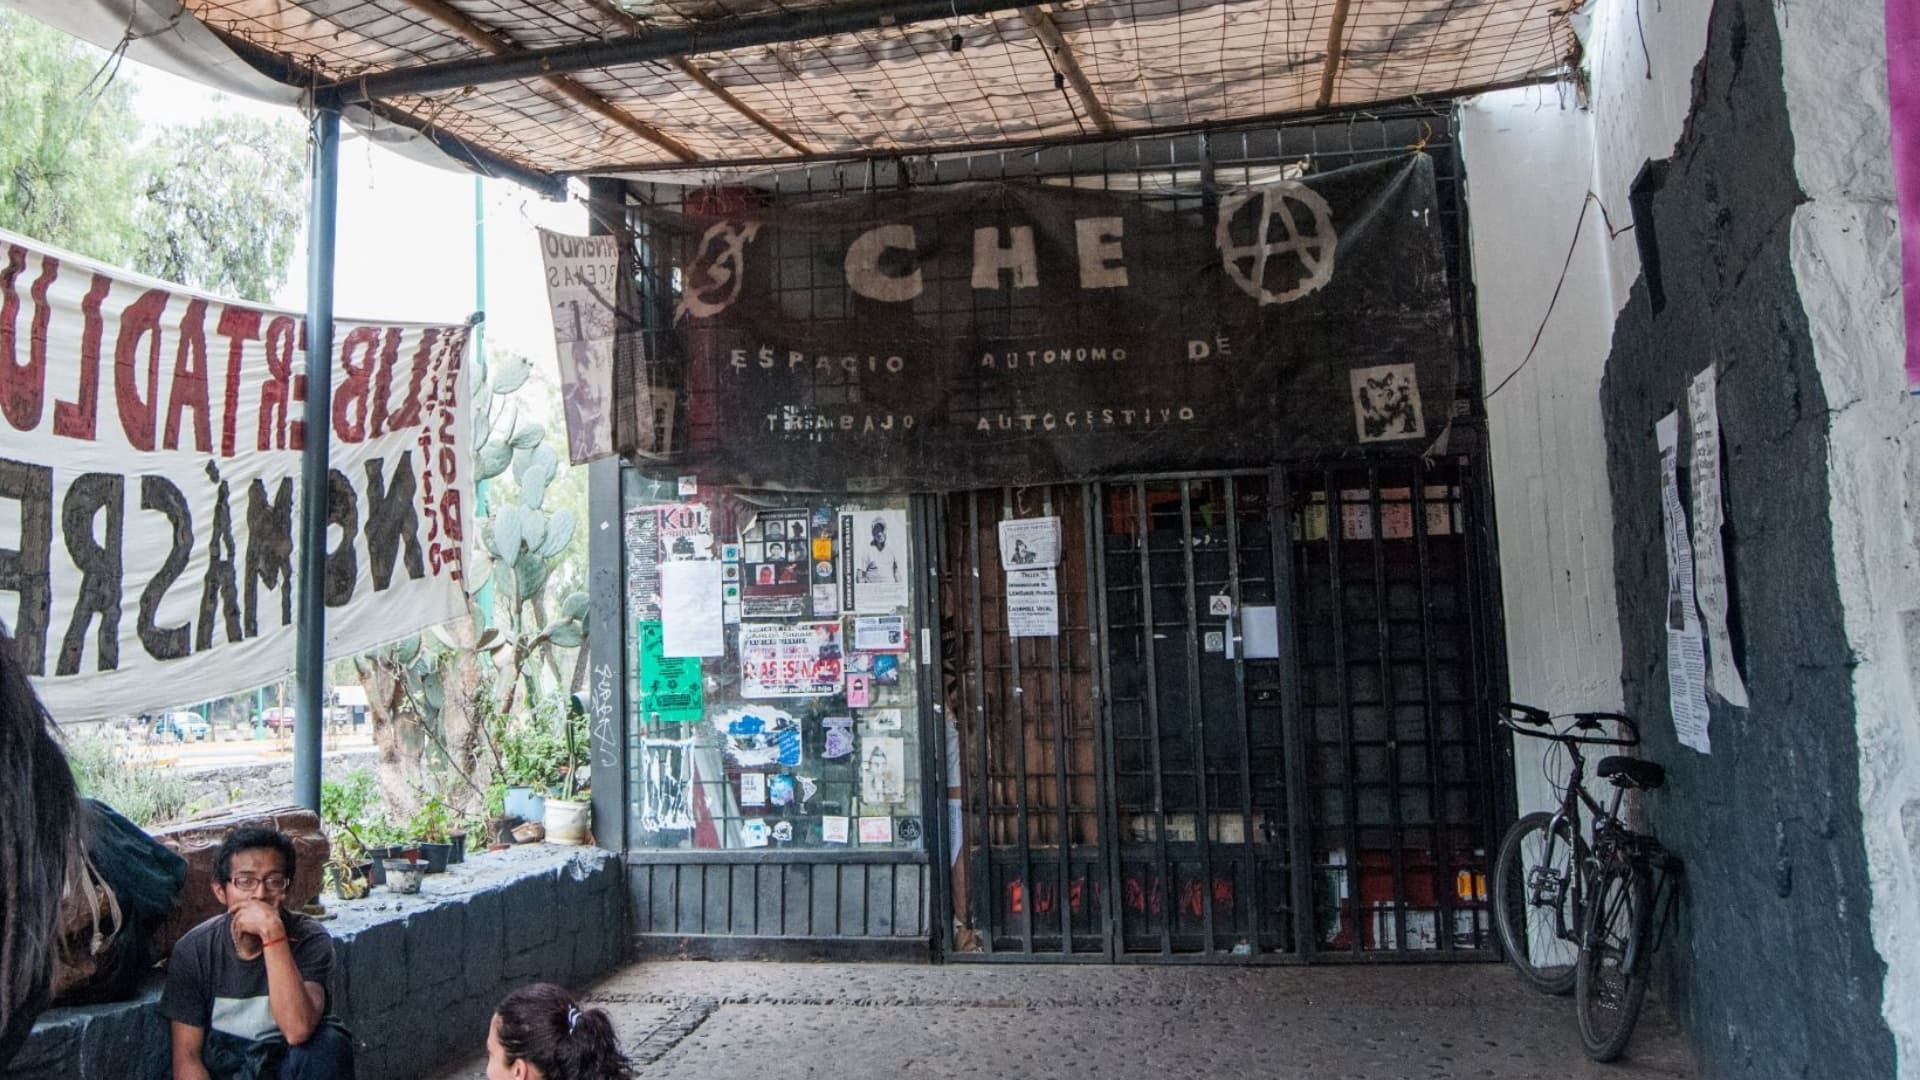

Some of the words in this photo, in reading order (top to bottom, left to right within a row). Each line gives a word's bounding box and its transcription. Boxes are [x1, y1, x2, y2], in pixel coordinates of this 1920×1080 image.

[844, 217, 1129, 301] CHE
[731, 349, 904, 373] ESPACIO
[981, 348, 1126, 369] AUTONOMO
[1188, 336, 1231, 360] DE
[767, 413, 914, 432] TRABAJO
[976, 407, 1195, 431] AUTOGESTIVO
